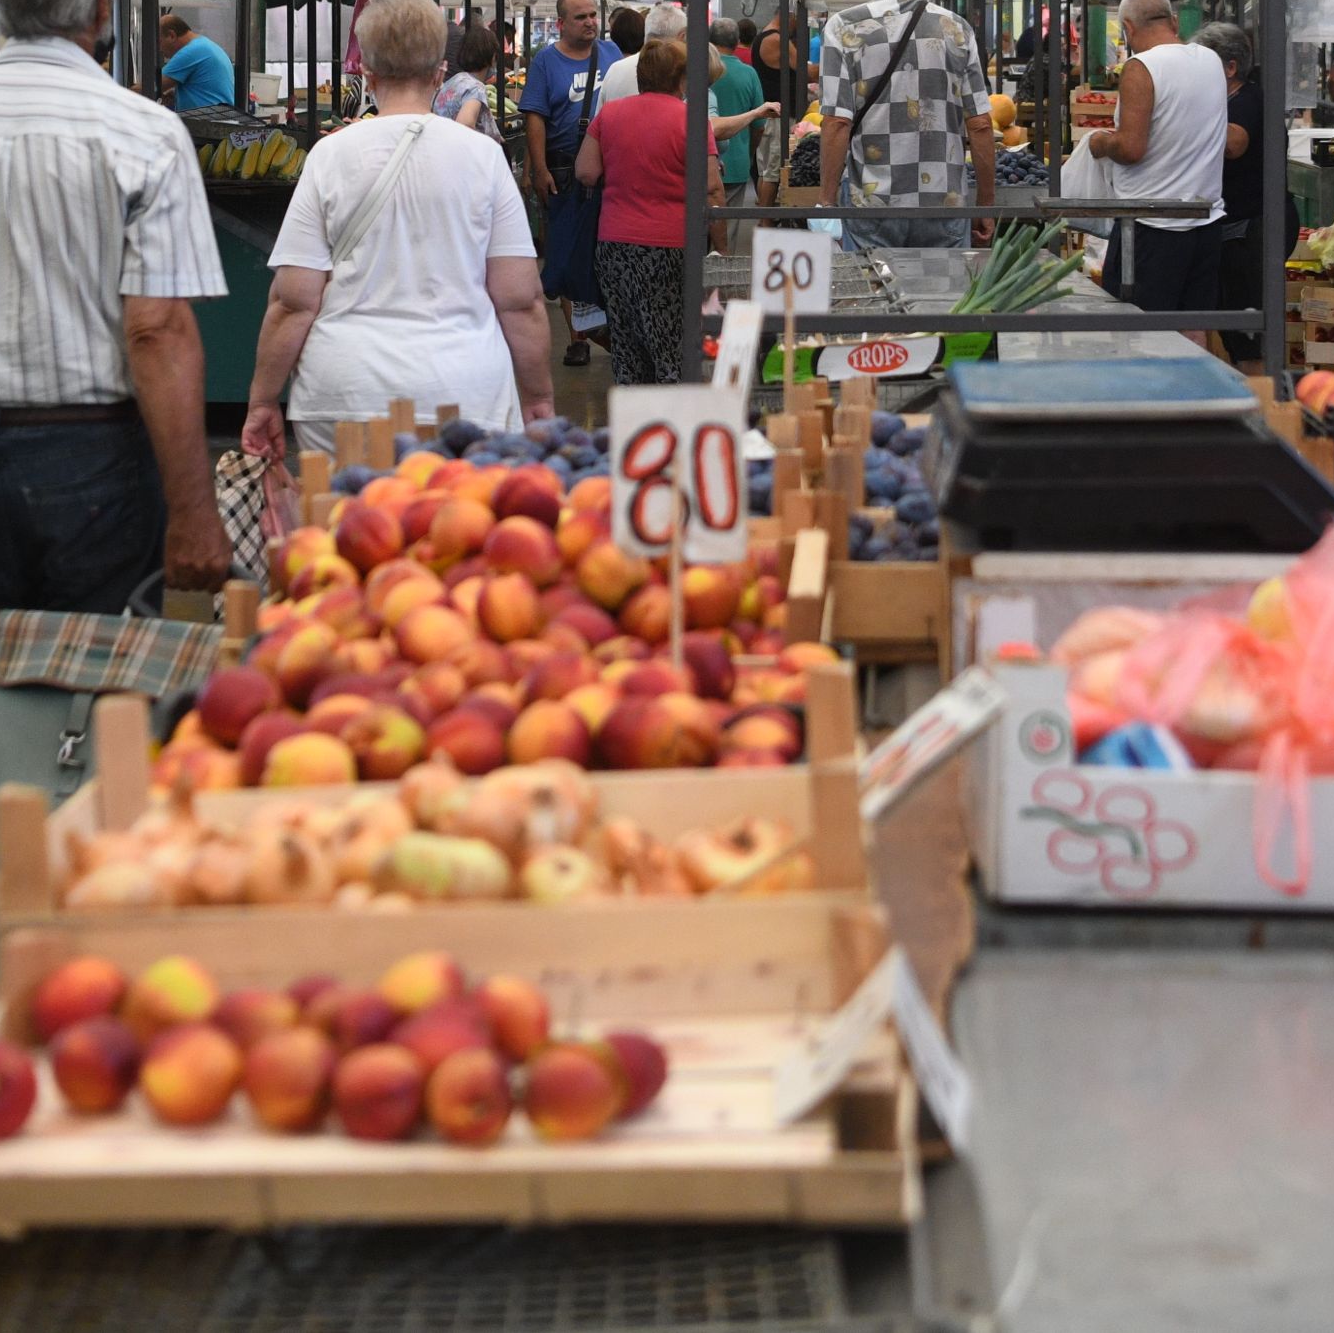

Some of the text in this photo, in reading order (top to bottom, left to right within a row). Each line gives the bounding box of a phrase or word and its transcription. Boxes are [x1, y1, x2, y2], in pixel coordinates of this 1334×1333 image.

[573, 69, 602, 89] NIE
[763, 249, 813, 292] 80
[851, 343, 906, 368] TROPS
[620, 421, 738, 546] 80
